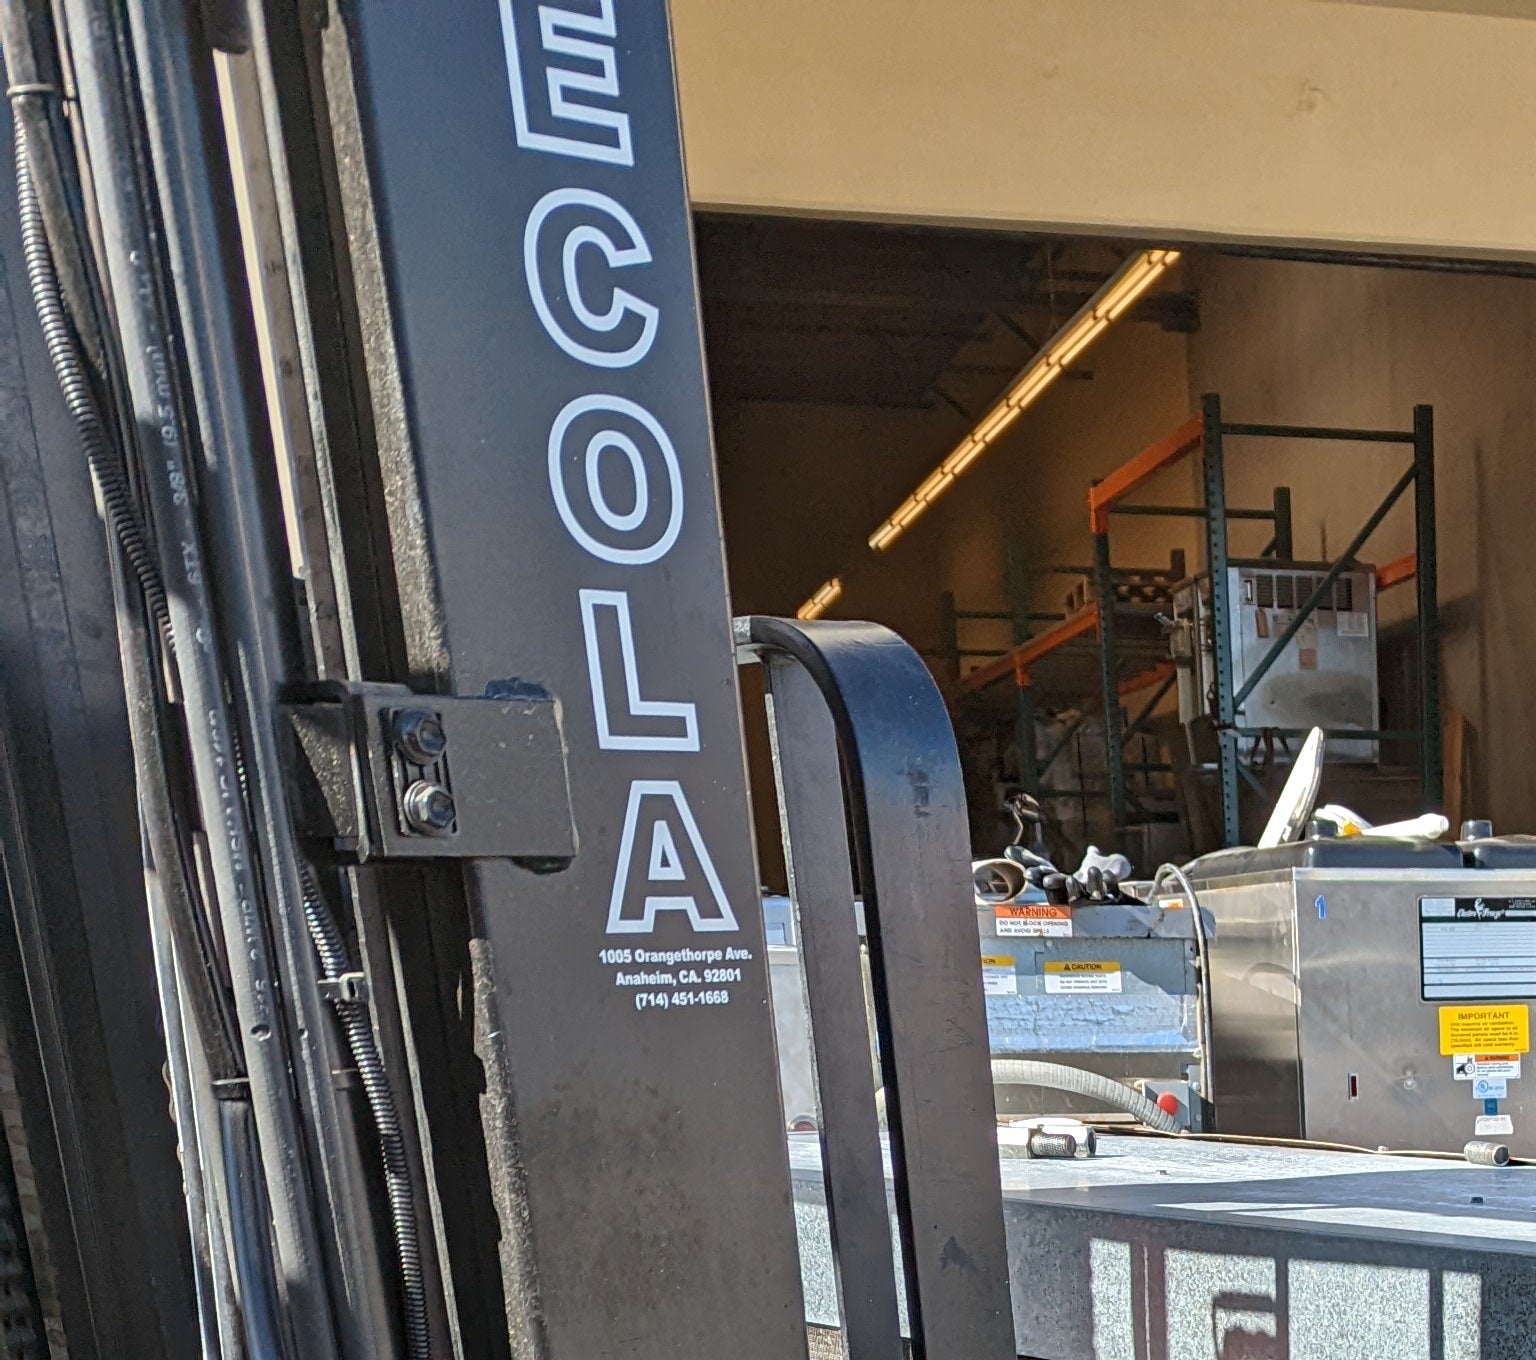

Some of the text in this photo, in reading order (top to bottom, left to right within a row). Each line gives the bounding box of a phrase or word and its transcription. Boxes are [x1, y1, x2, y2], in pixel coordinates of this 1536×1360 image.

[1009, 907, 1057, 917] WARNING
[599, 946, 752, 965] 1005 Orangethorpe Ave.
[615, 968, 741, 987] Anaheim, CA. 92801
[635, 990, 729, 1011] (714) 451-1668
[1458, 1012, 1510, 1020] IMPORTANT
